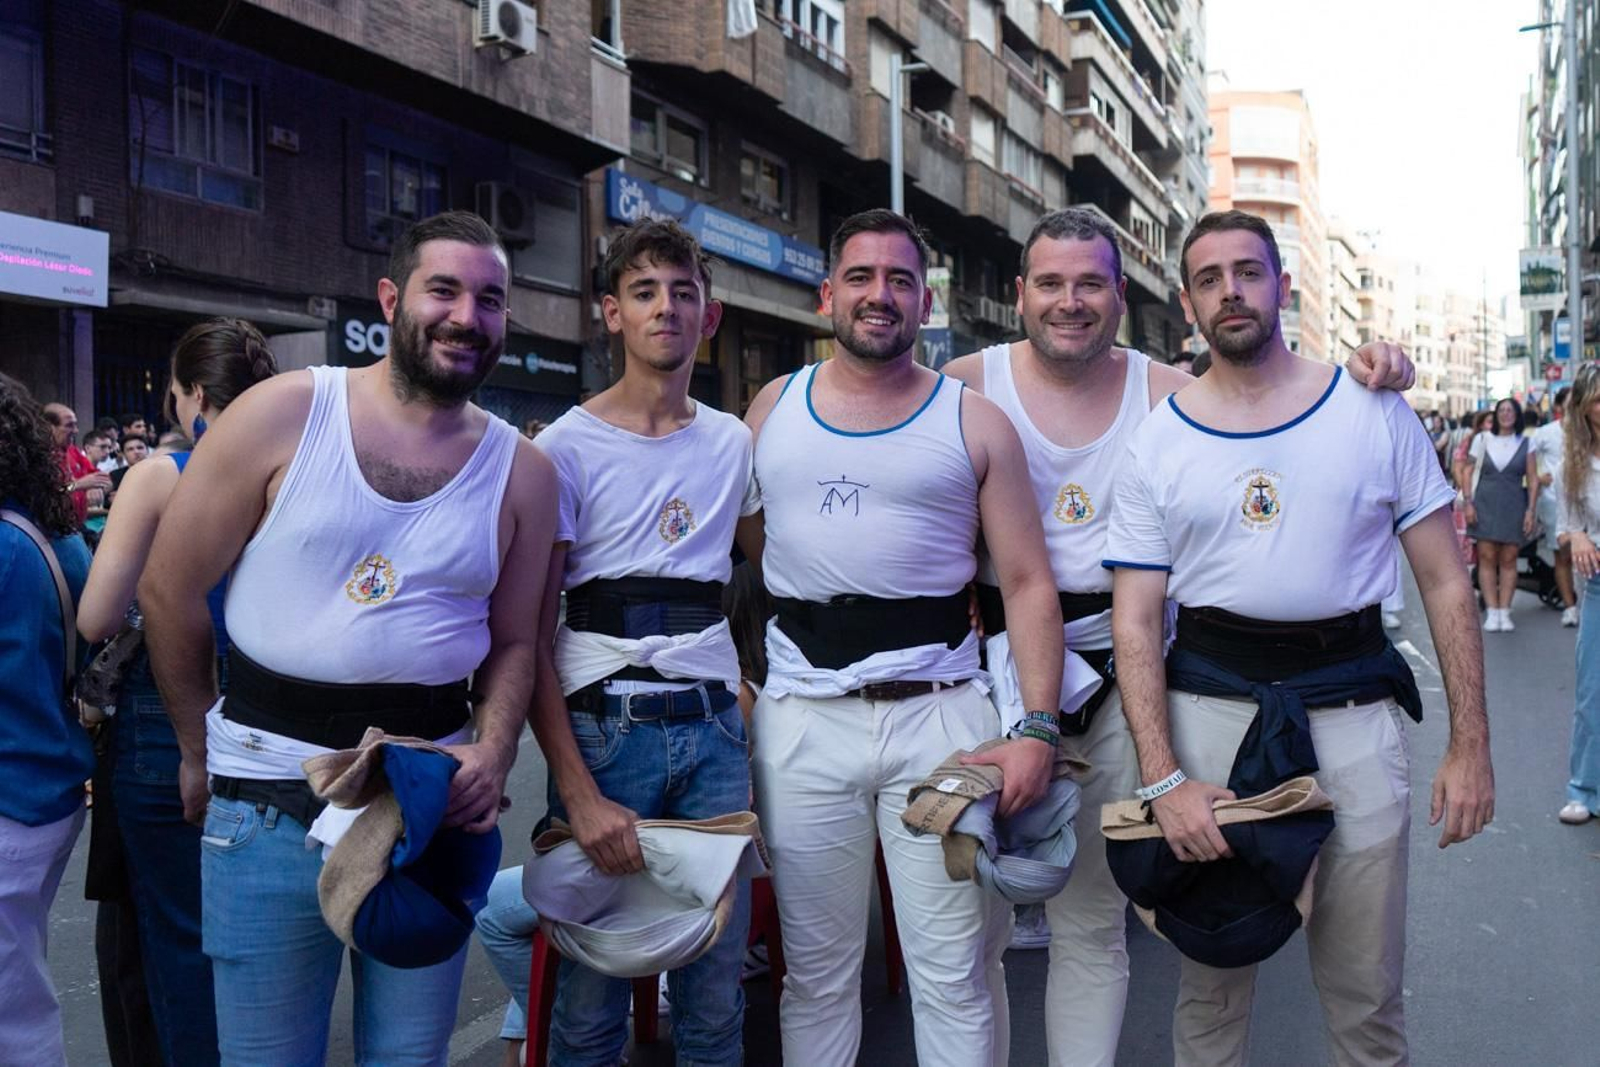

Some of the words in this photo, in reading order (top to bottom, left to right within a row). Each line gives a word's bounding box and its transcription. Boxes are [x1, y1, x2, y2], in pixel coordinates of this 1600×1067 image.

[35, 246, 71, 260] Premium
[701, 227, 737, 253] EVENTOS
[741, 242, 772, 265] CURSOS
